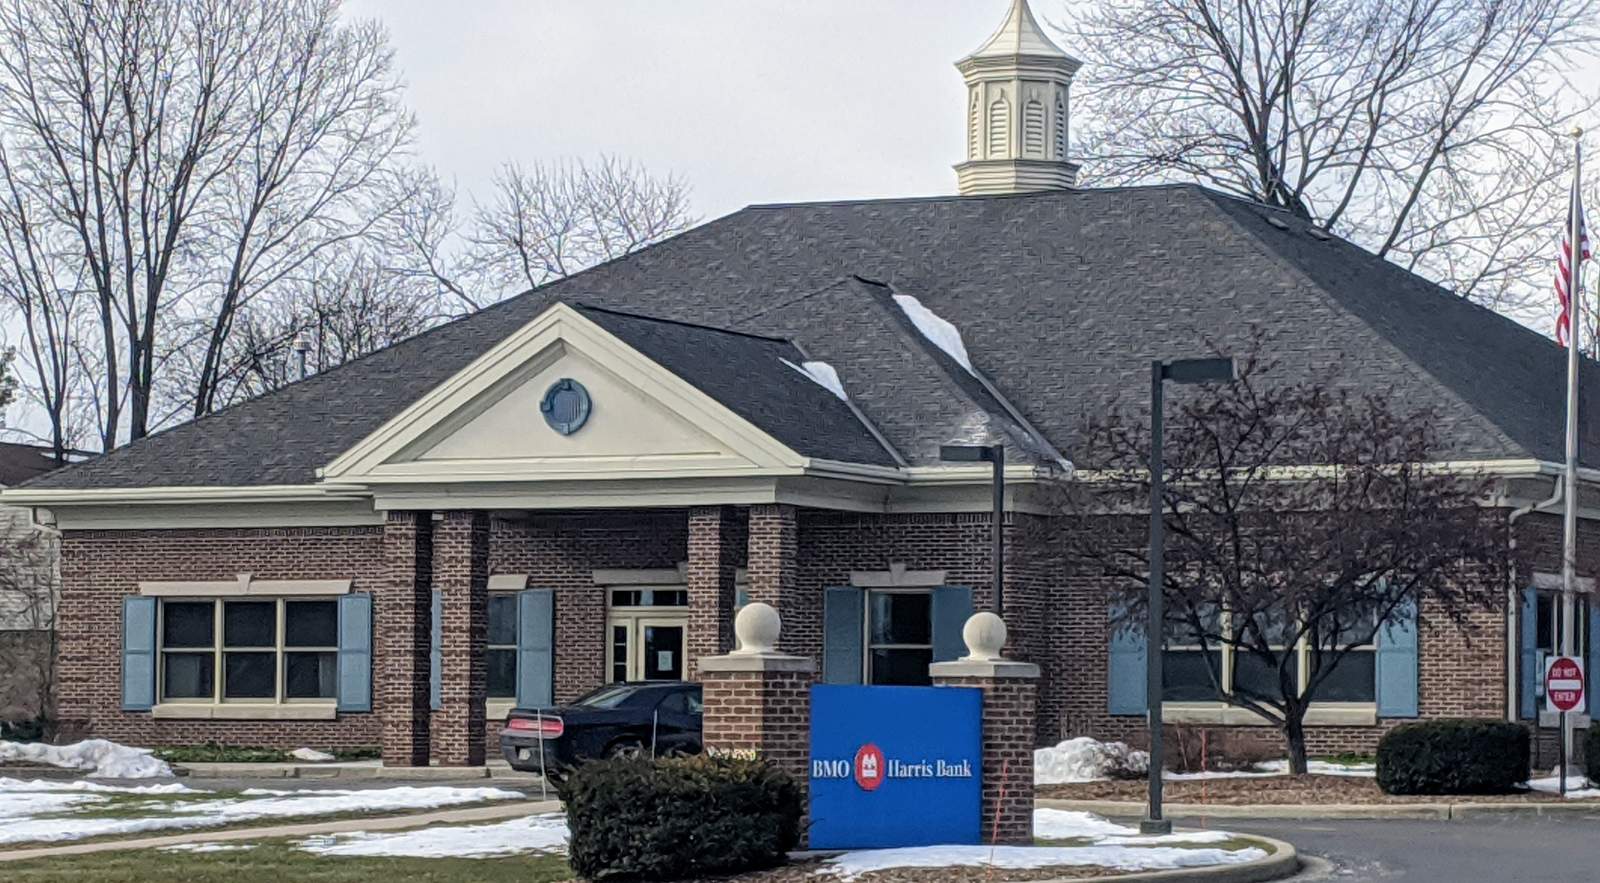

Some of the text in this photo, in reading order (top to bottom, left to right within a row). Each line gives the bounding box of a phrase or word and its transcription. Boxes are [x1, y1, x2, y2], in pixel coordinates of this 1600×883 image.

[1552, 667, 1577, 678] DO NOT
[1554, 691, 1576, 702] ENTER
[812, 759, 973, 778] BMO Harris Bank
